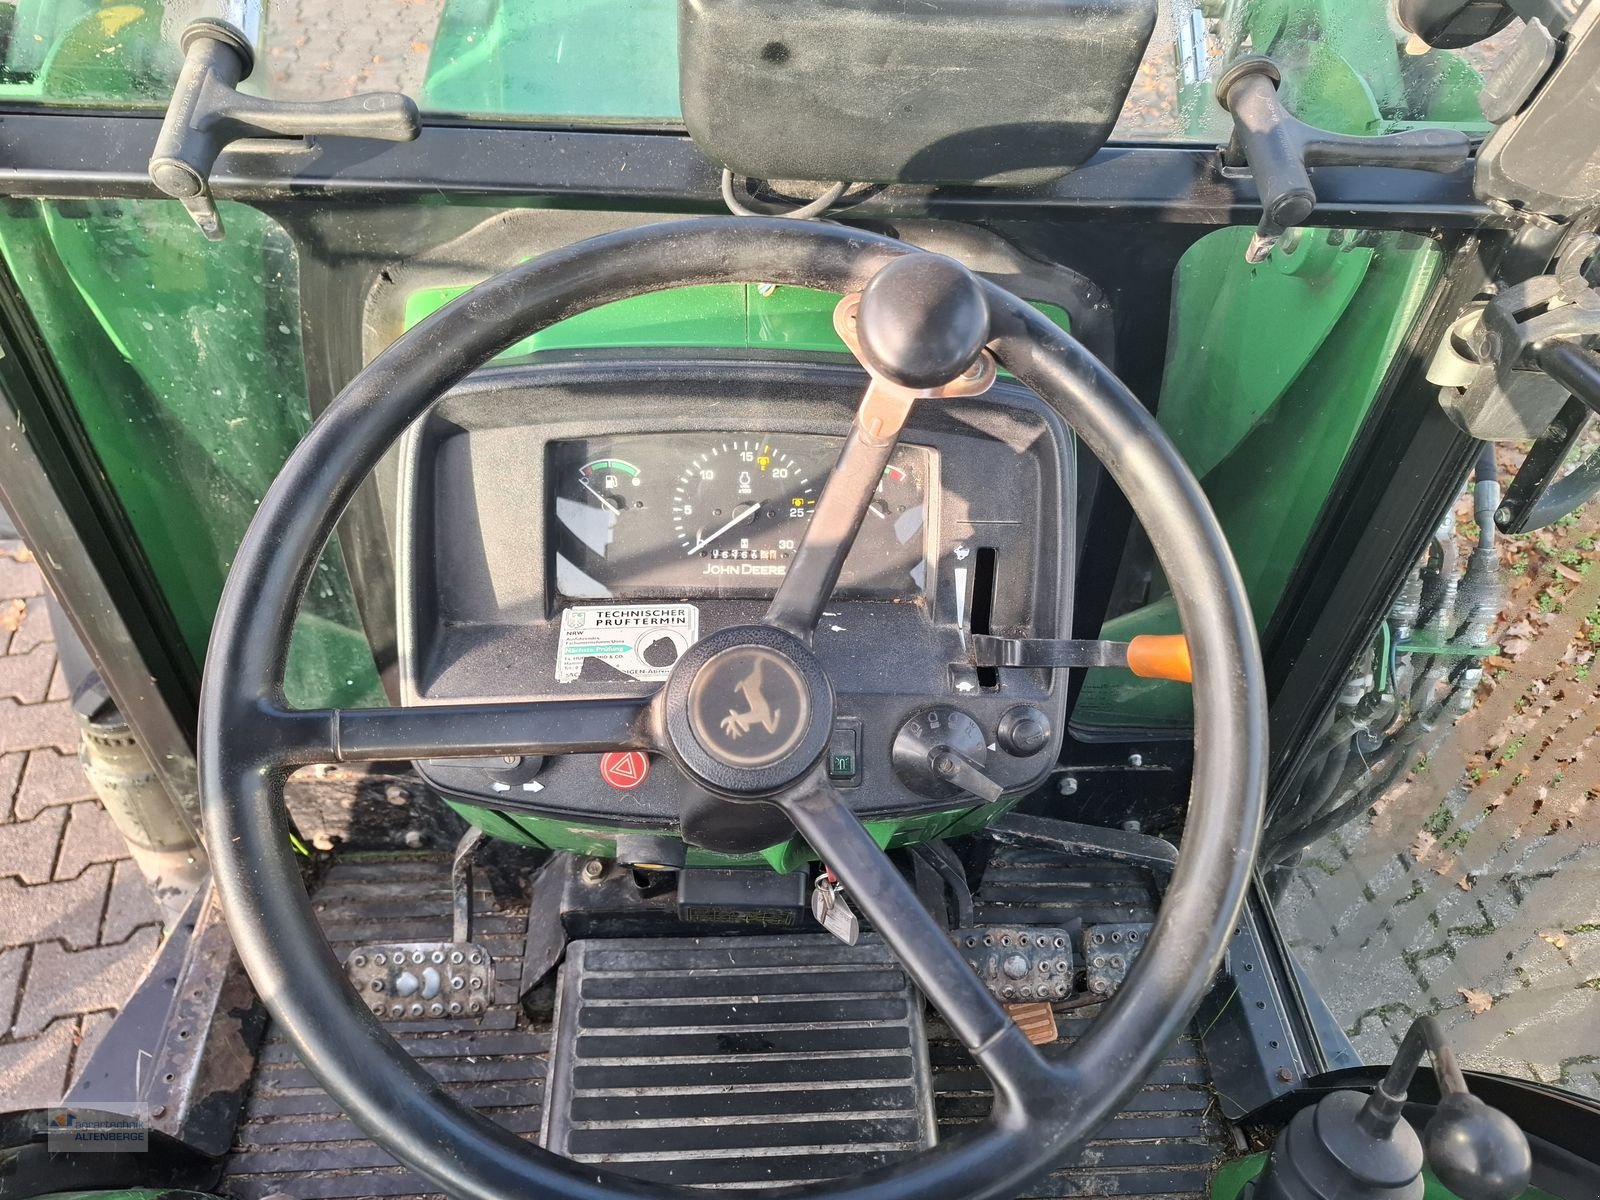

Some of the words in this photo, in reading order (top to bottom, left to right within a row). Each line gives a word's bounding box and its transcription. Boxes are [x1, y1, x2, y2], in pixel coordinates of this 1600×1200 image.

[739, 451, 754, 462] 15
[699, 470, 714, 480] 10
[772, 468, 788, 479] 20
[684, 505, 693, 515] 5
[789, 508, 804, 518] 25
[778, 540, 794, 550] 30
[702, 563, 740, 576] JOHN
[741, 563, 786, 576] DEERE
[597, 609, 686, 618] TECHNISCHER
